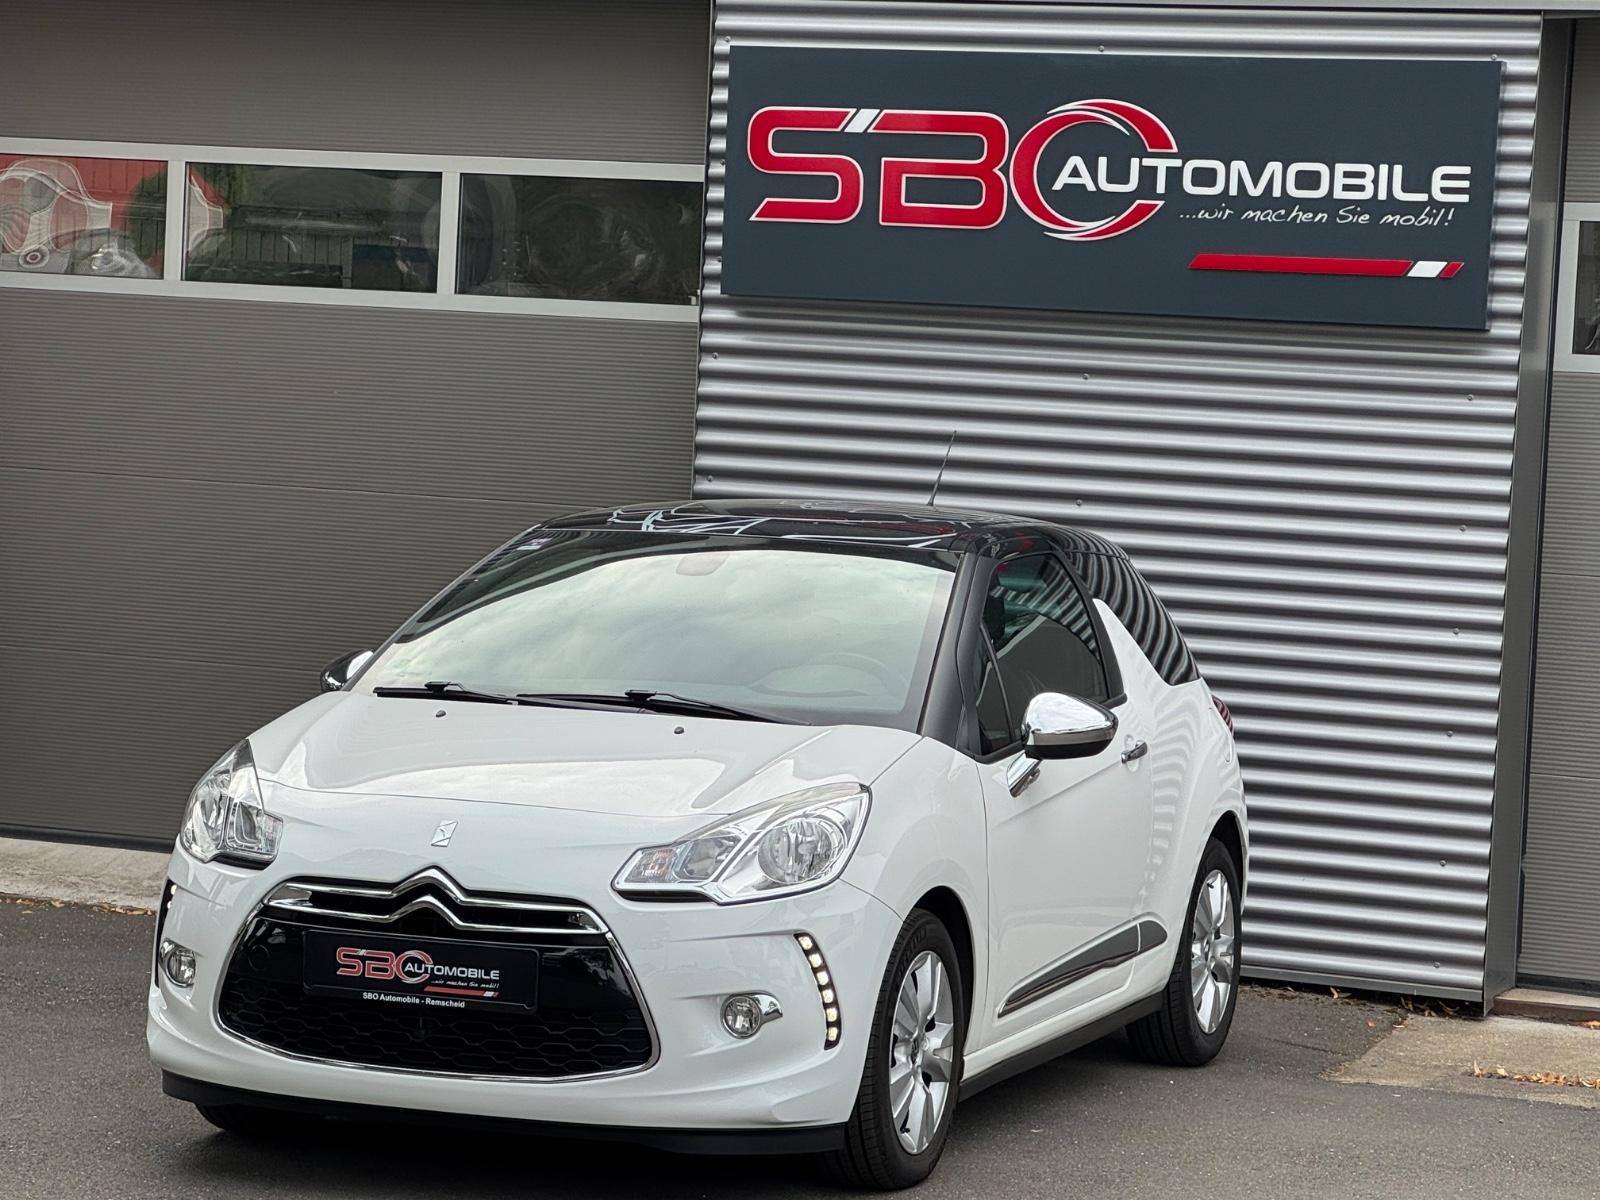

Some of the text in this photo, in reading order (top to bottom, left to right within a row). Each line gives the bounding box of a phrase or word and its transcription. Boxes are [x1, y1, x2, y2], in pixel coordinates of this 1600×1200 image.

[1051, 154, 1471, 203] AUTOMOBILE
[1240, 204, 1328, 224] machen
[1336, 205, 1370, 225] Sie
[1379, 206, 1454, 227] mobil!
[404, 962, 500, 980] AUTOMOBILE
[362, 991, 379, 1000] SBO
[380, 993, 420, 1004] Automobile
[425, 997, 465, 1008] Remscheid
